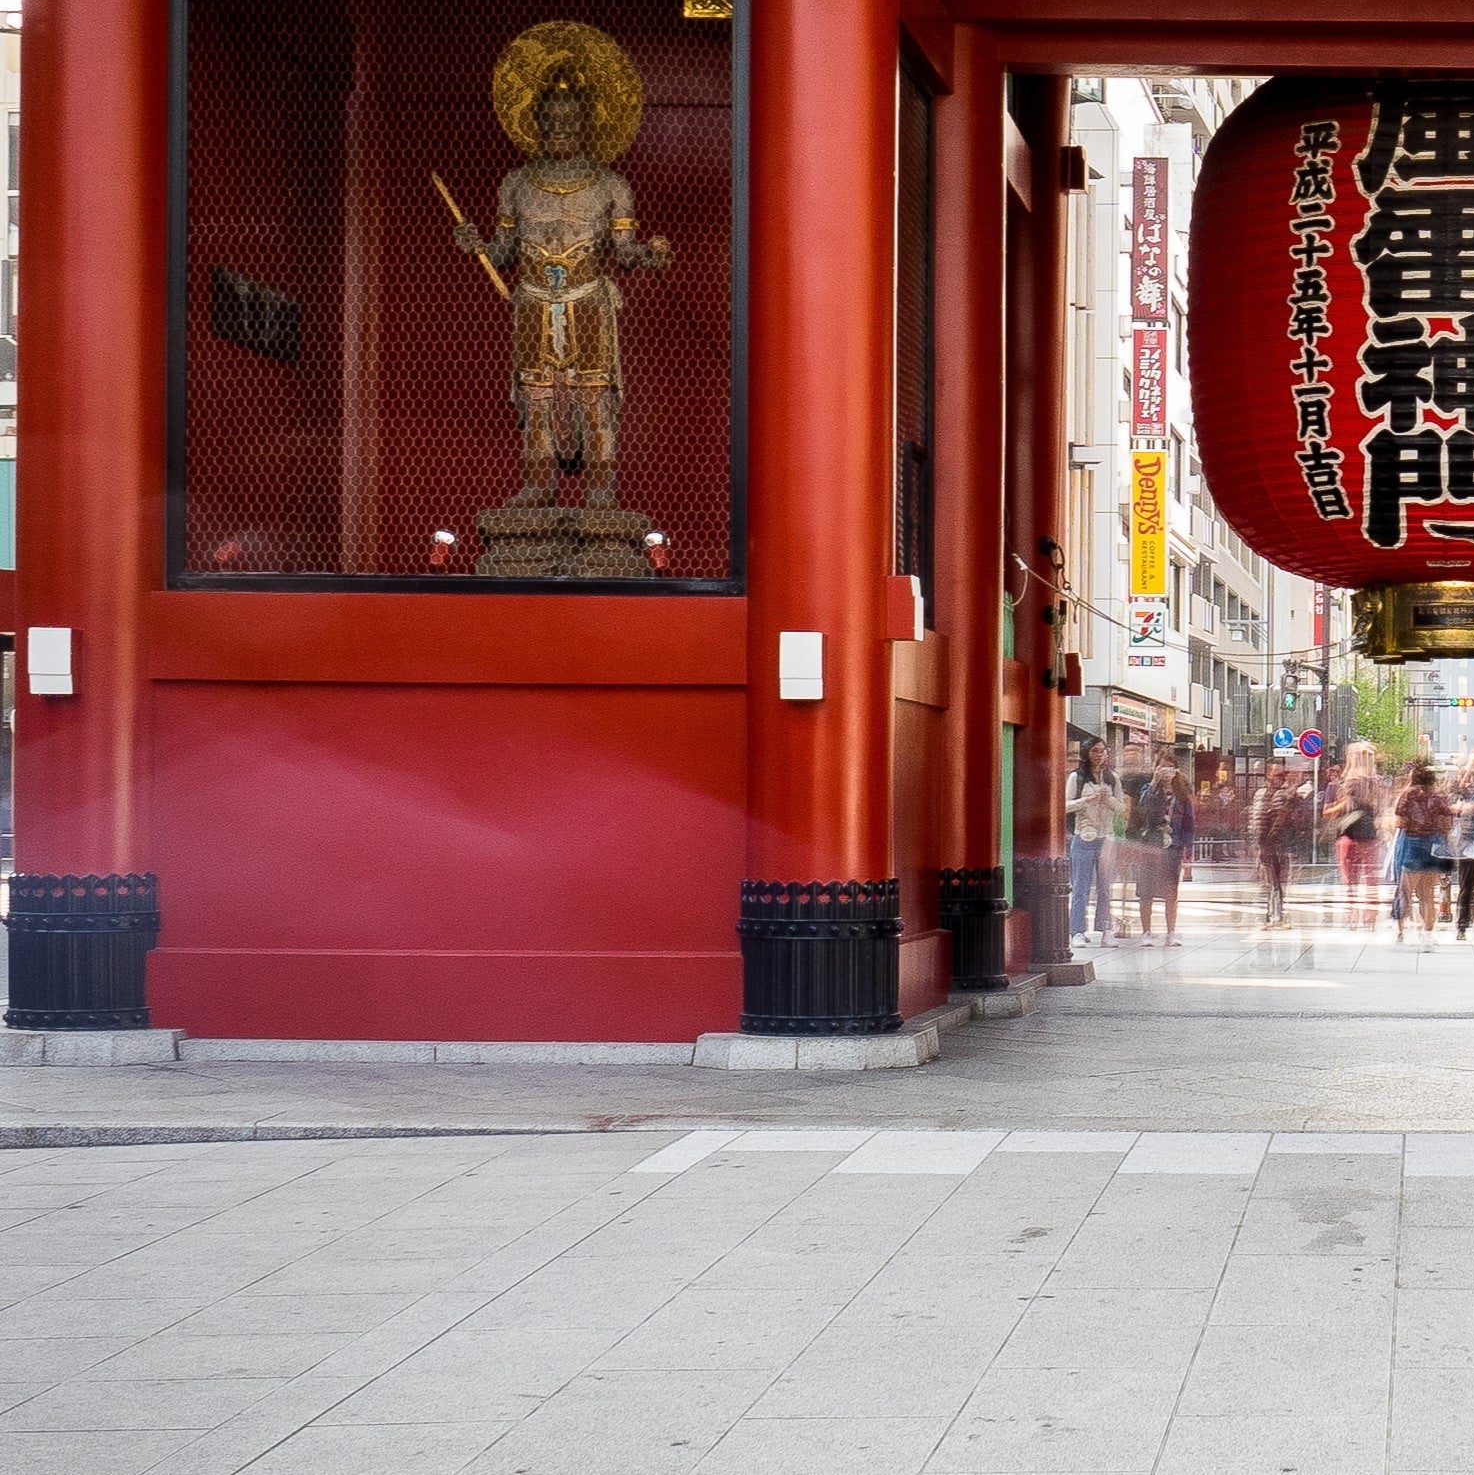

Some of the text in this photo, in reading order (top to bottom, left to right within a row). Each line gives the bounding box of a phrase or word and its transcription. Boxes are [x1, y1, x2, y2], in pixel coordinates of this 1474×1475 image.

[1287, 121, 1352, 519] 平成二十五年十一月吉日
[1133, 456, 1164, 535] Denny's
